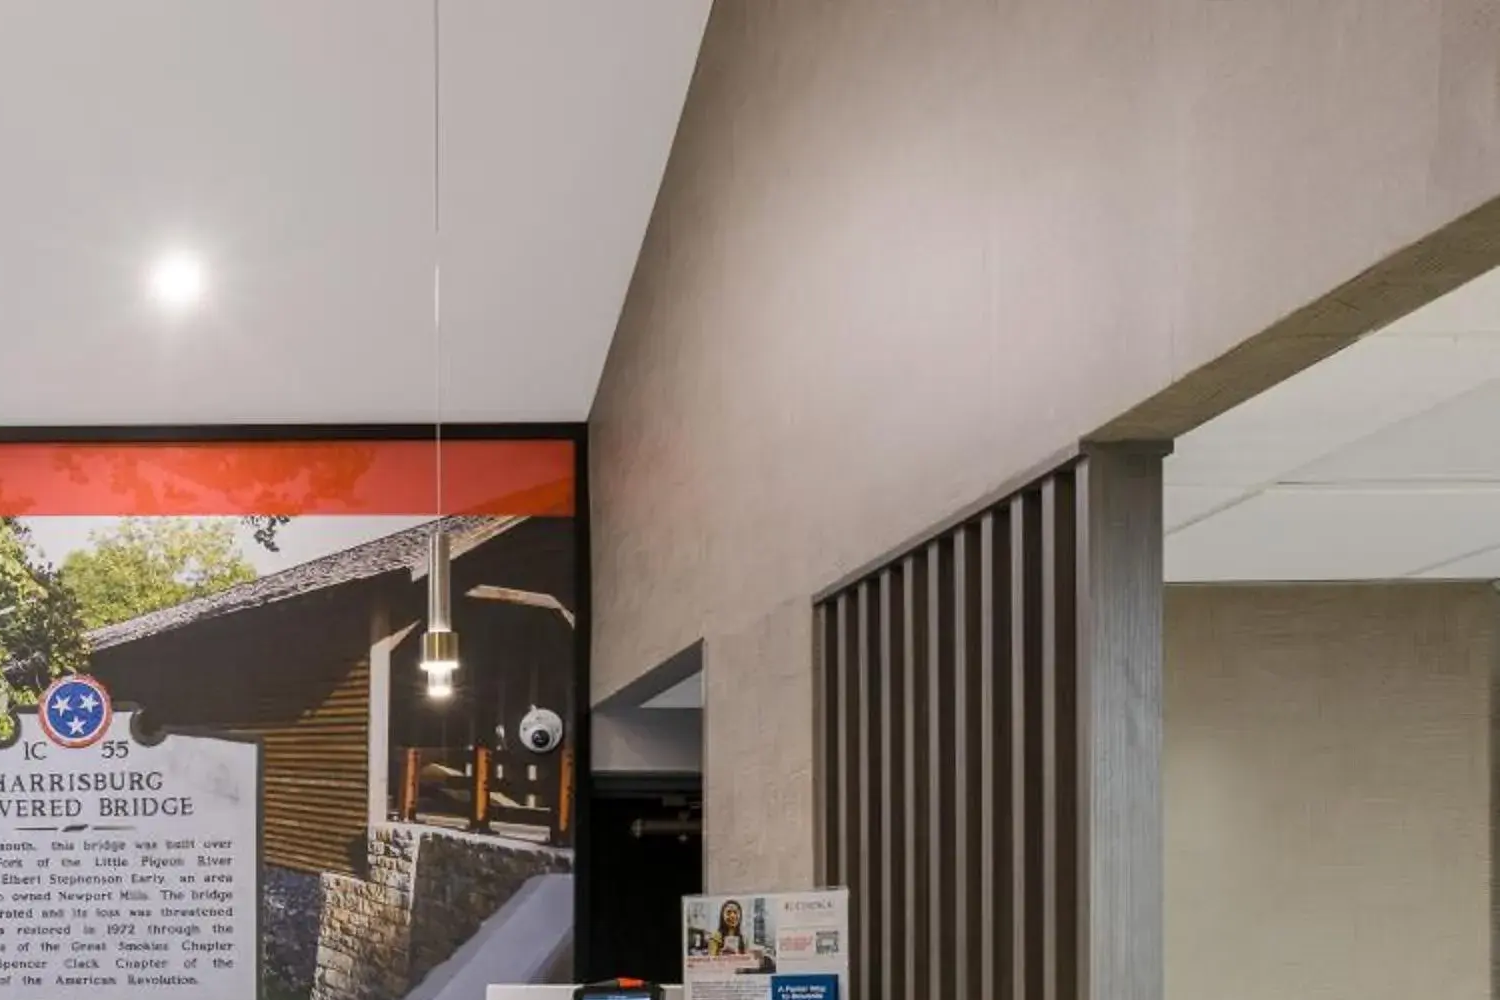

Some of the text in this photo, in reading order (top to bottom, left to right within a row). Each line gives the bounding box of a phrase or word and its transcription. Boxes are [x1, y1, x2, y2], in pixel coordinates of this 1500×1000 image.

[101, 740, 129, 759] 55
[99, 797, 194, 817] BRIDGE
[51, 842, 74, 851] this
[84, 840, 126, 852] bridge
[135, 842, 157, 850] was
[203, 840, 232, 848] over
[37, 858, 50, 868] of
[61, 858, 80, 867] the
[95, 857, 128, 868] Little
[141, 856, 184, 868] Pigeon
[198, 856, 232, 866] River
[2, 874, 40, 884] Elbert
[50, 874, 122, 886] Stephenson
[204, 874, 232, 883] area
[12, 892, 51, 901] owned
[58, 892, 112, 902] Newport
[160, 890, 185, 900] The
[191, 890, 233, 902] bridge
[42, 909, 64, 918] and
[161, 907, 233, 917] threatened
[17, 925, 70, 935] restored
[107, 924, 135, 935] 1972
[148, 924, 200, 936] through
[212, 924, 233, 933] the
[17, 942, 30, 952] of
[41, 942, 60, 952] the
[71, 941, 106, 952] Great
[182, 940, 233, 952] Chapter
[116, 958, 168, 970] Chapter
[184, 958, 197, 969] of
[213, 958, 233, 968] the
[22, 976, 42, 985] the
[56, 976, 116, 985] American
